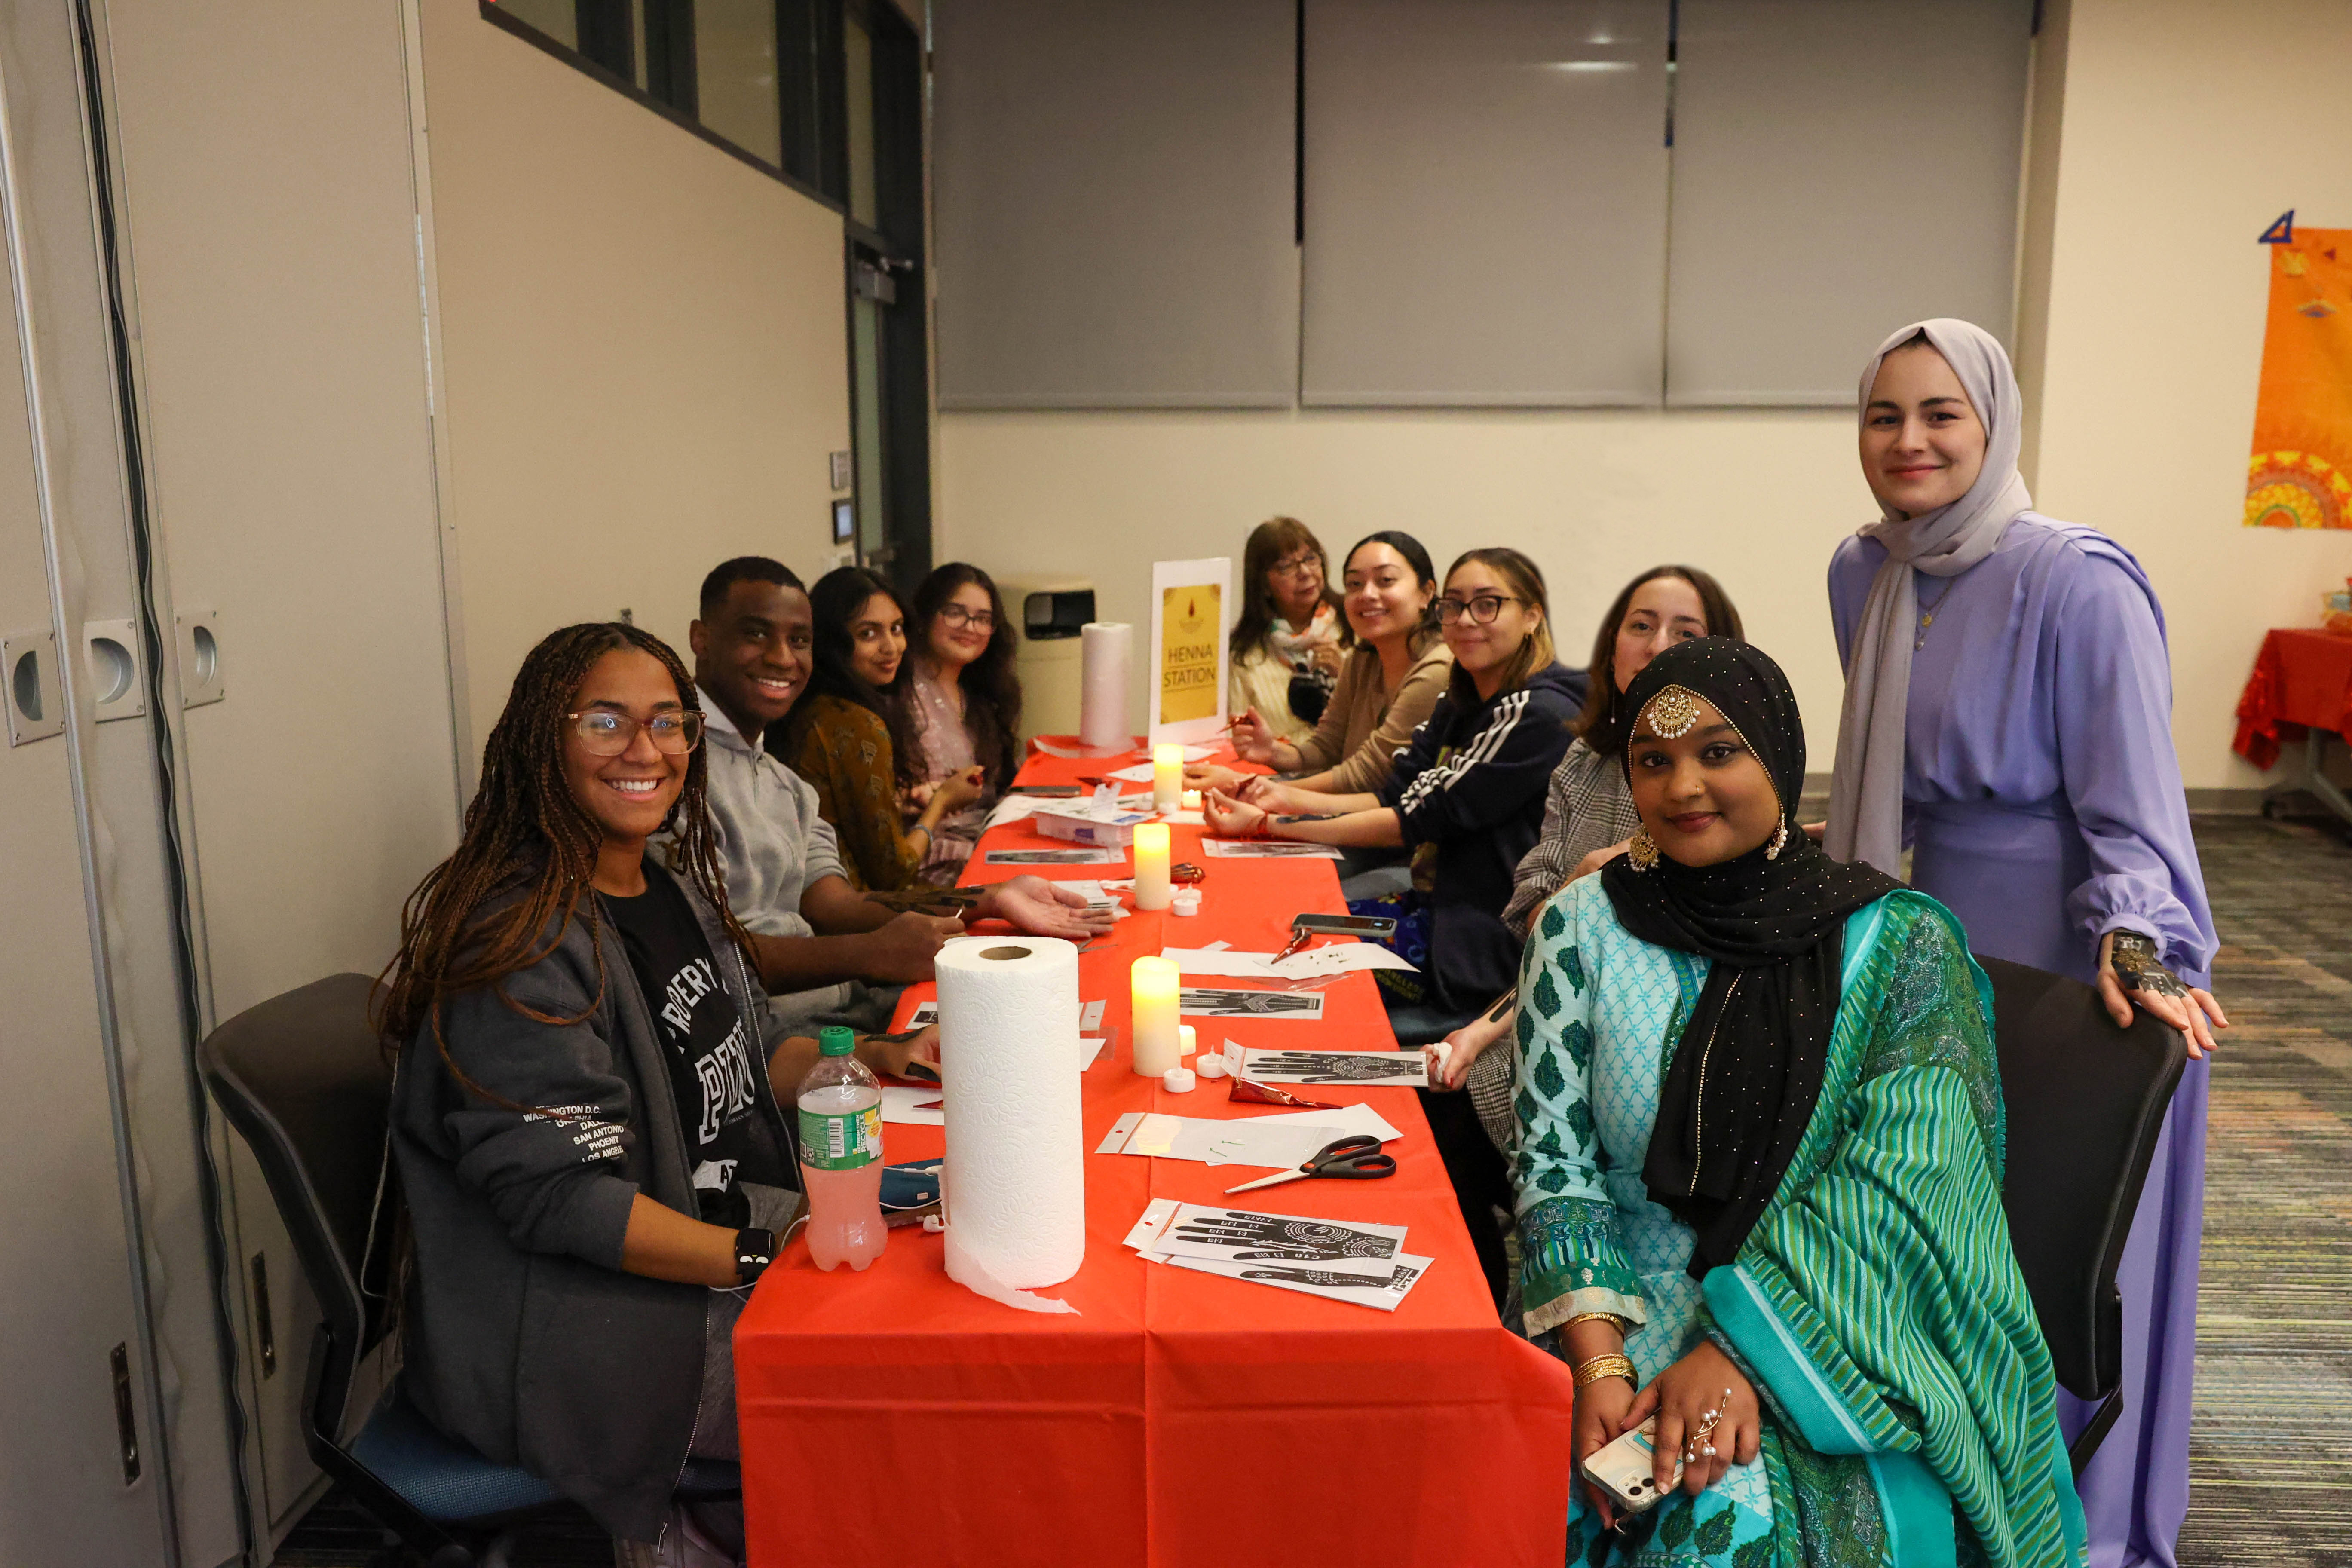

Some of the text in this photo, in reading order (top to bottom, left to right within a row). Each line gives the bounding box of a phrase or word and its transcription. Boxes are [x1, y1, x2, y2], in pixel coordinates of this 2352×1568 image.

[1168, 644, 1213, 663] HENNA
[1164, 667, 1216, 687] STATION
[523, 1106, 583, 1123] WASNGTON
[585, 1106, 601, 1114] D.C.
[573, 1125, 624, 1145] SAN ANTONIO
[588, 1136, 619, 1151] PHOENIX
